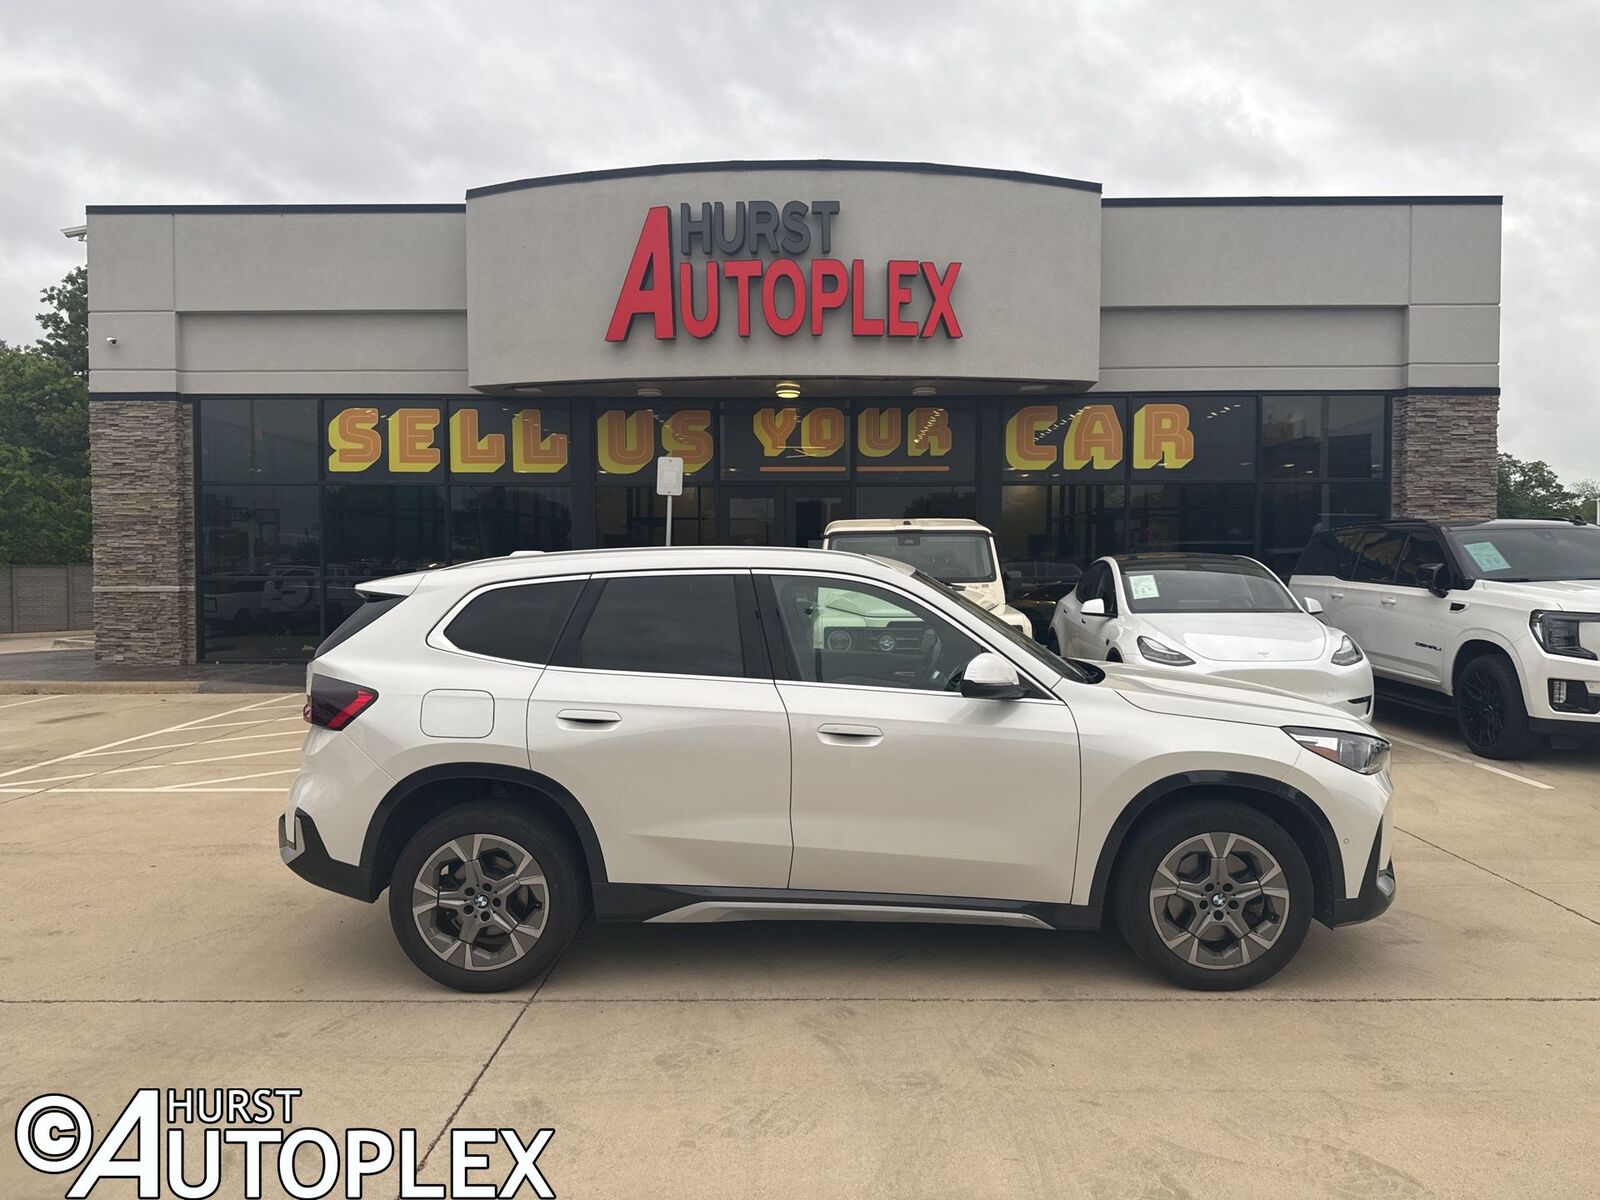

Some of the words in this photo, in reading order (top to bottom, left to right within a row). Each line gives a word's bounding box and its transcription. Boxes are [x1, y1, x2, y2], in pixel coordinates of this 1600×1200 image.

[680, 200, 840, 256] HURST
[605, 205, 963, 342] AUTOPLEX
[328, 407, 568, 473] SELL
[597, 409, 714, 475] US
[753, 407, 952, 457] YOUR
[1005, 404, 1194, 470] CAR
